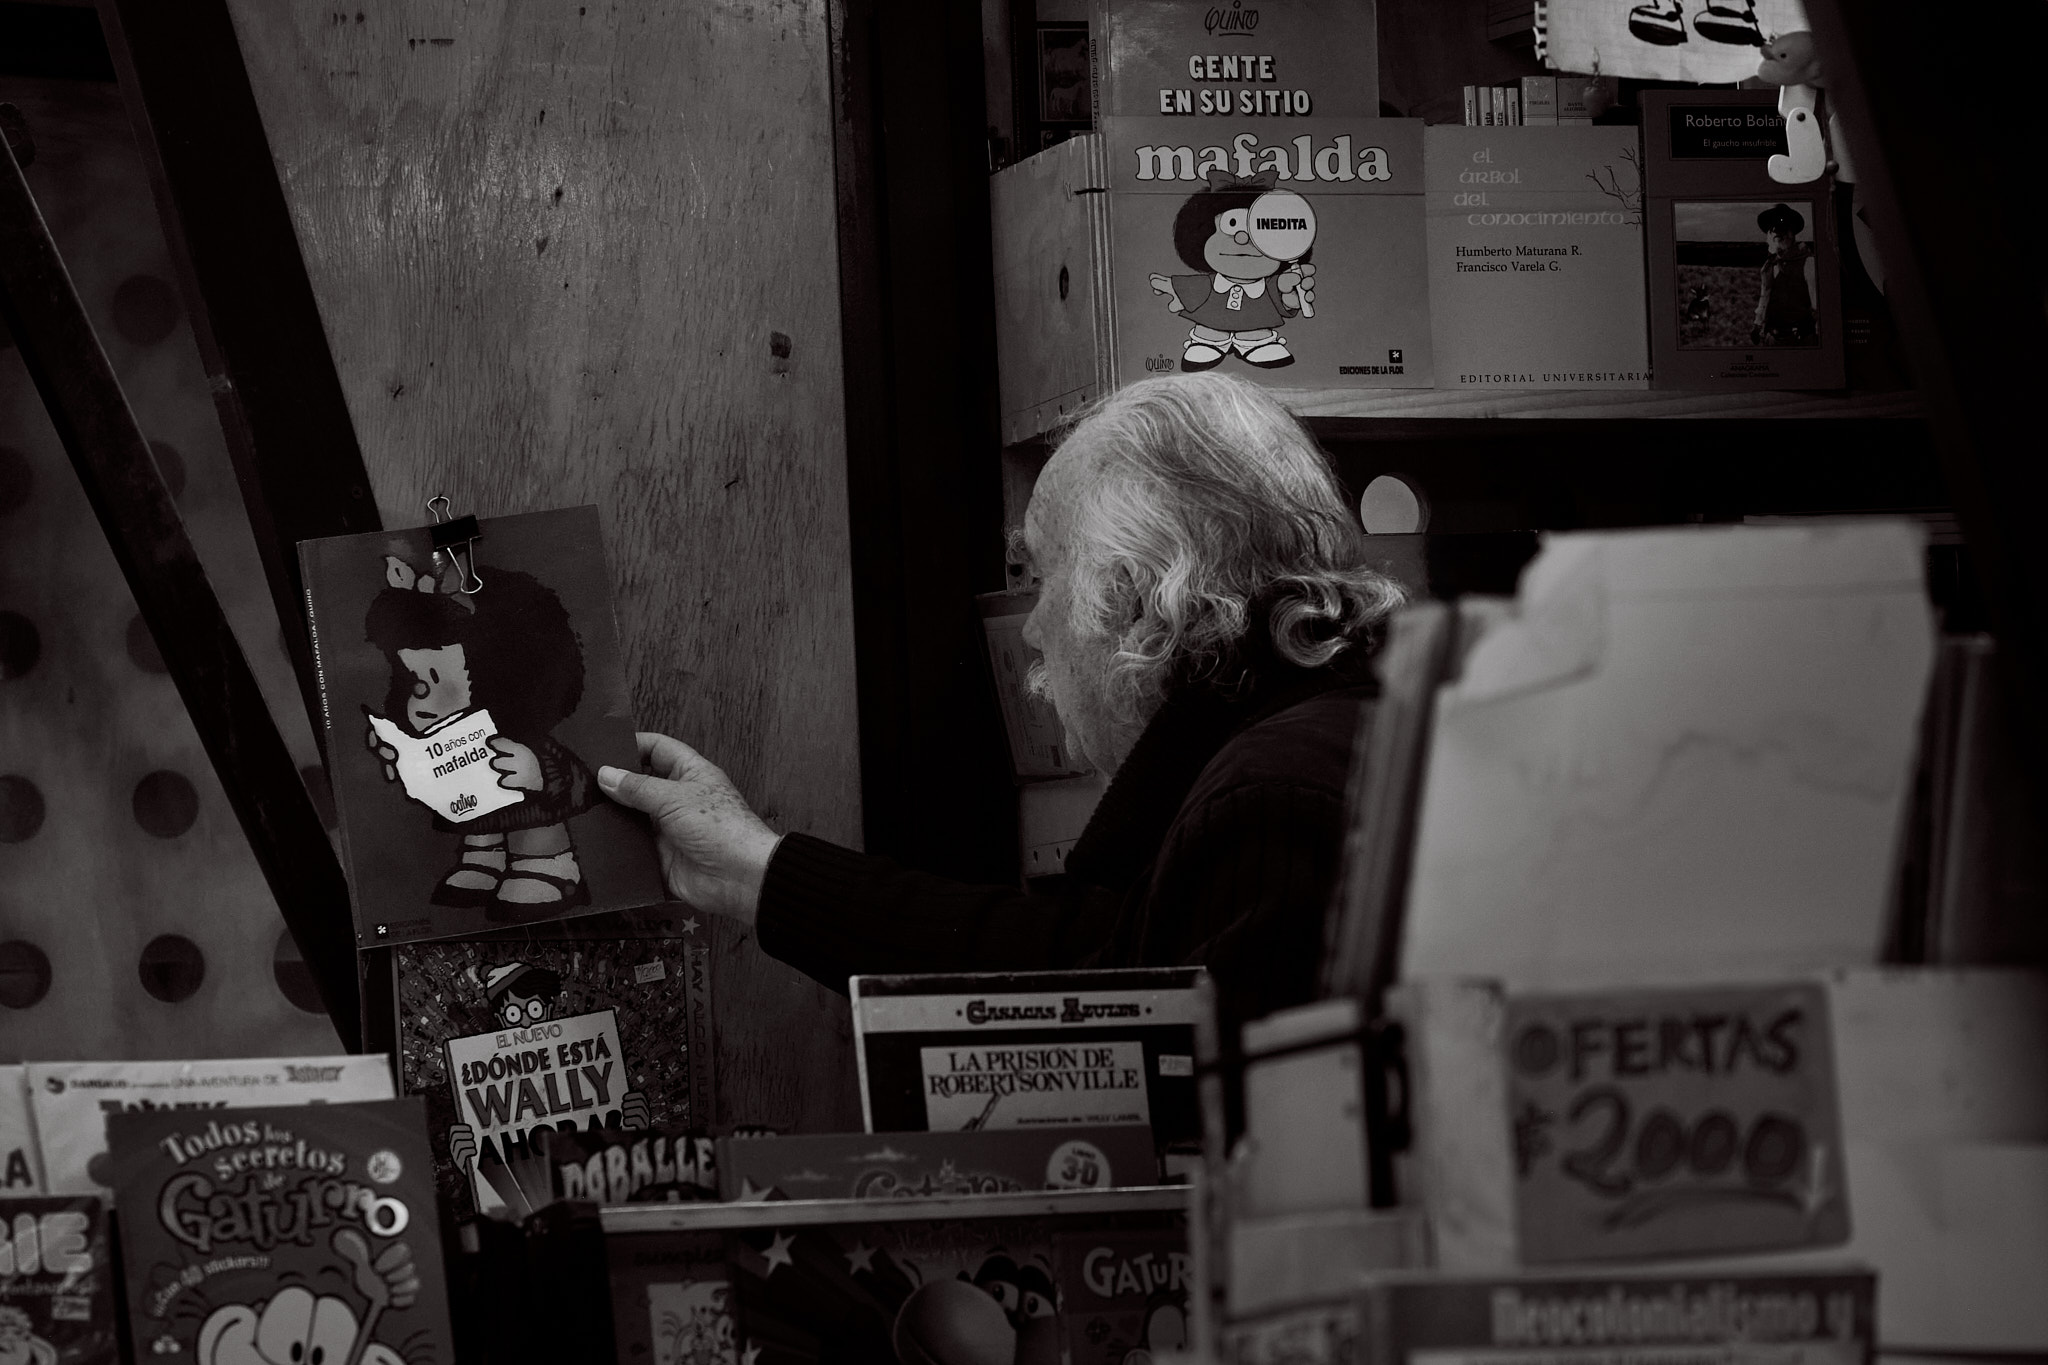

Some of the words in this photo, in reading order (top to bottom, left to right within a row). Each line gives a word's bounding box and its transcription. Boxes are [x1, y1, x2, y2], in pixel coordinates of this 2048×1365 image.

[1188, 54, 1277, 82] GENTE
[1159, 88, 1196, 117] EN
[1200, 88, 1235, 117] SU
[1239, 88, 1313, 117] SITIO
[1685, 114, 1742, 127] Roberto
[1746, 113, 1788, 127] Bolañ
[1135, 133, 1392, 182] mafalda
[1472, 147, 1494, 164] el
[1703, 138, 1711, 147] El
[1712, 138, 1740, 150] gaucho
[1454, 191, 1489, 207] del
[1256, 217, 1308, 231] INEDITA
[1467, 210, 1624, 226] conocimiento
[1456, 246, 1512, 257] Humberto
[1515, 245, 1567, 256] Maturana
[1571, 245, 1582, 256] R.
[1456, 261, 1508, 272] Francisco
[1511, 261, 1545, 272] Varela
[1549, 260, 1562, 272] G.
[1339, 366, 1371, 375] EDICIONES
[1372, 366, 1381, 375] DE
[1382, 366, 1389, 375] LA
[1389, 366, 1404, 375] FLOR
[1460, 374, 1535, 383] EDITORIAL
[1543, 371, 1650, 382] UNIVERSITARIA
[305, 588, 315, 618] QUINO
[311, 625, 322, 668] MAFALDA
[318, 670, 326, 690] CON
[425, 742, 444, 760] 10
[444, 736, 468, 752] años
[468, 728, 486, 742] con
[433, 747, 489, 778] mafalda
[496, 1033, 512, 1049] EL
[513, 1023, 563, 1046] NUEVO
[1512, 1008, 1804, 1083] OFERTAS
[461, 1047, 551, 1087] ¿DÓNDE
[557, 1032, 612, 1068] ESTÁ
[949, 1052, 982, 1073] LA
[1084, 1049, 1114, 1069] DE
[465, 1060, 614, 1130] WALLY
[930, 1069, 1140, 1098] ROBERTSONVILLE
[159, 1120, 262, 1165] Todos
[0, 1149, 33, 1188] A
[214, 1139, 346, 1181] secretos
[157, 1170, 410, 1255] Gaturro
[0, 1211, 94, 1276] IE
